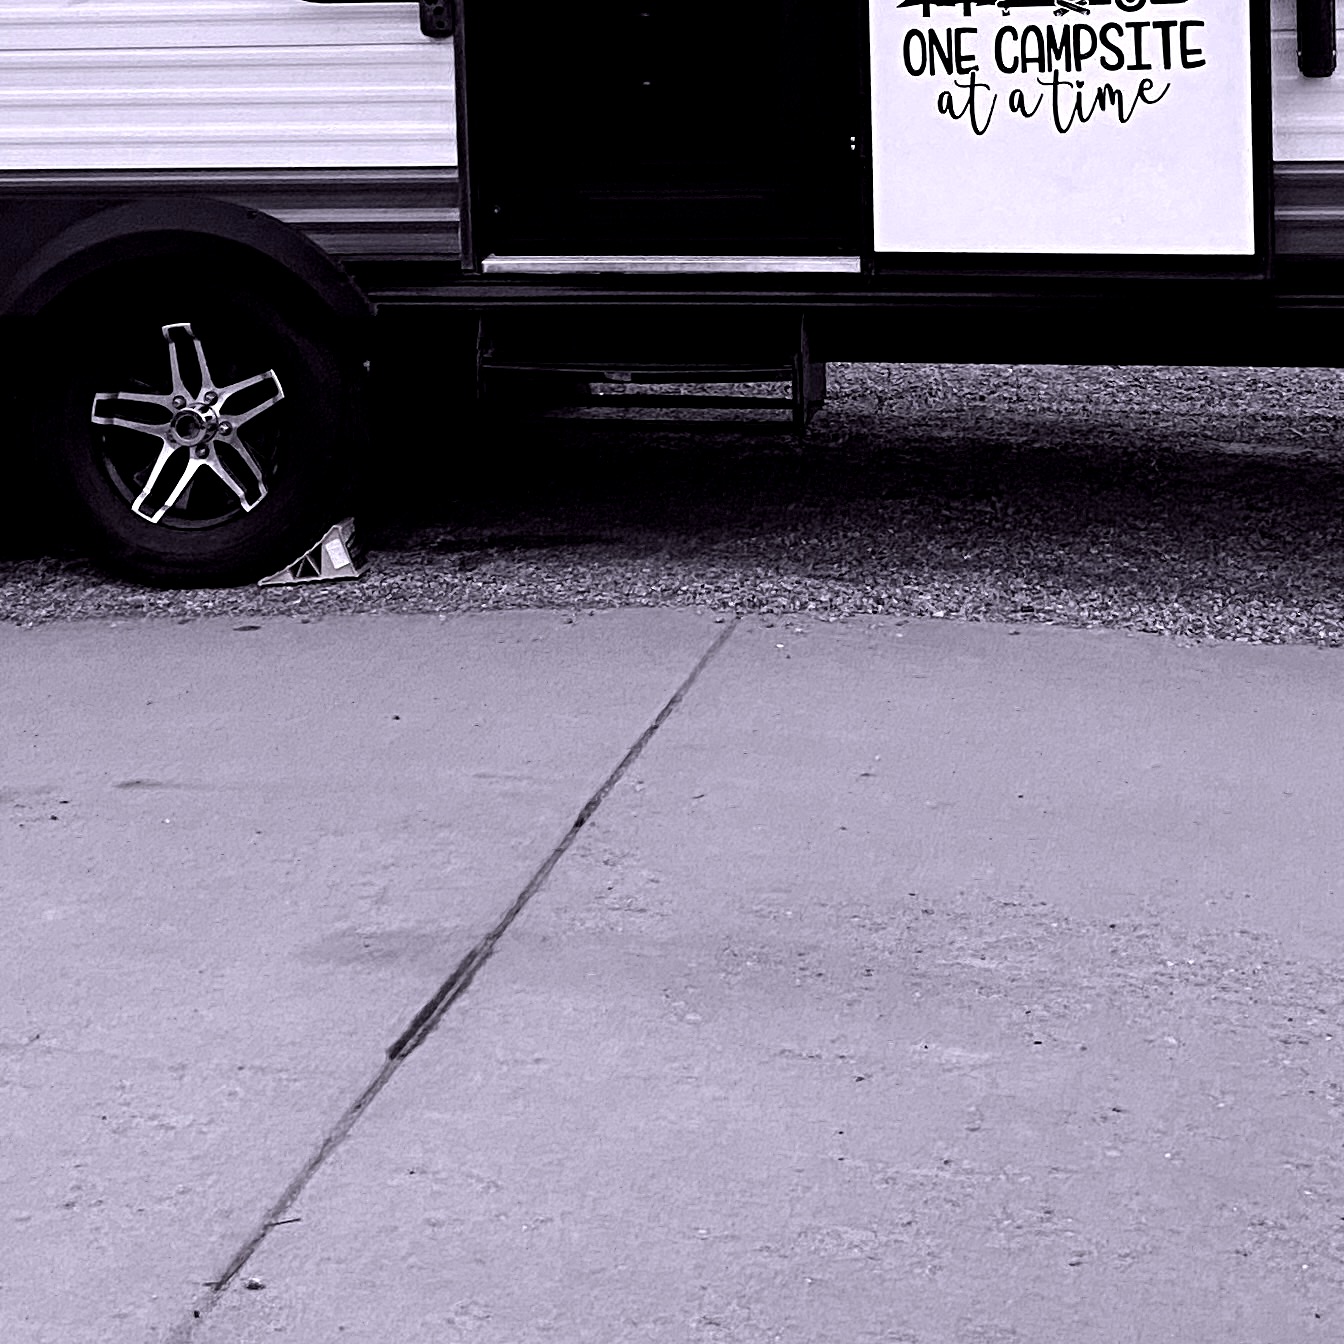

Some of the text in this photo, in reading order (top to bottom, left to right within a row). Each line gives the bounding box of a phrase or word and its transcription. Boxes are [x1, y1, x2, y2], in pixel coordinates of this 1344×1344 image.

[903, 20, 1206, 76] ONE CAMPSITE
[937, 69, 1171, 136] at a time
